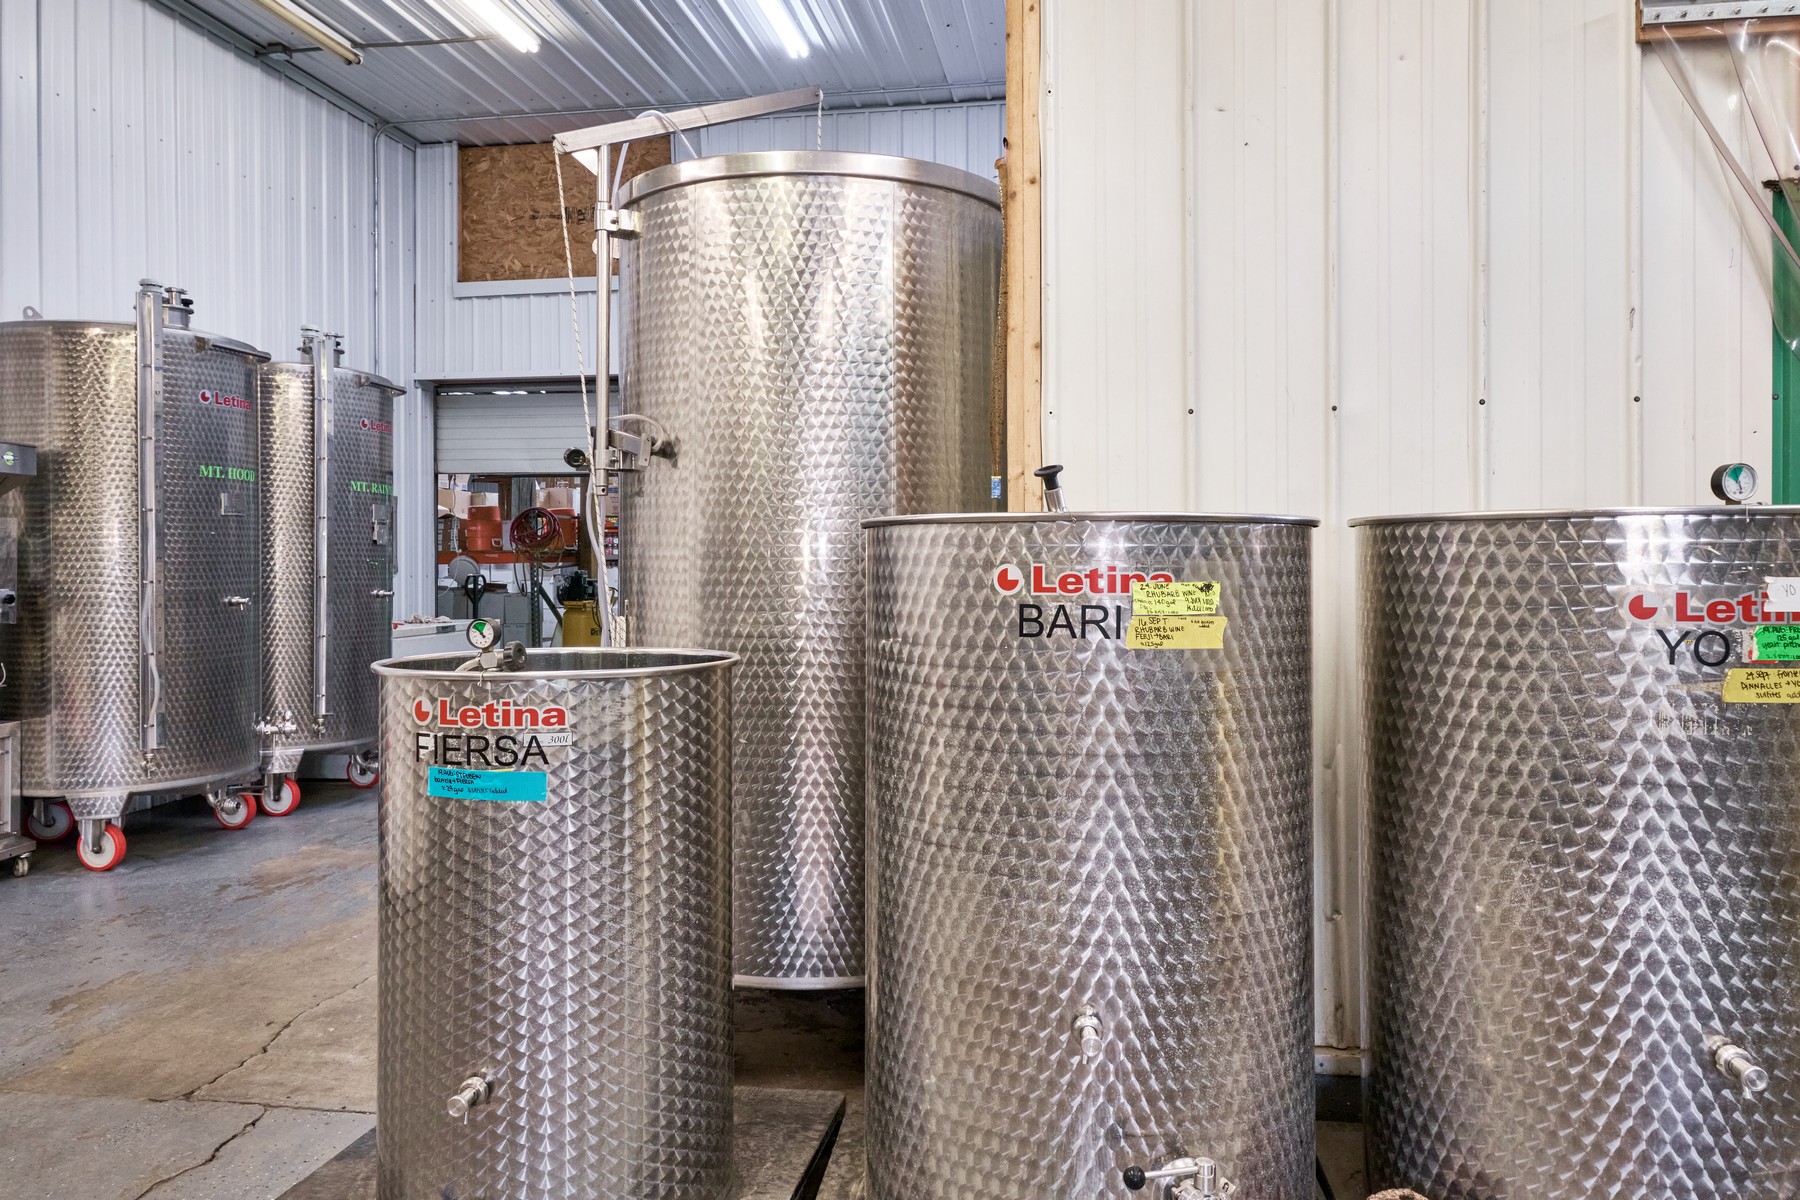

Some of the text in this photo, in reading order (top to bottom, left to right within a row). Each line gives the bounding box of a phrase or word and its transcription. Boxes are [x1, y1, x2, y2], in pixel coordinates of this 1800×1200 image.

[214, 391, 251, 411] Letina
[199, 465, 255, 481] MT. HOOD
[350, 481, 370, 493] MT.
[1146, 590, 1180, 598] RHUBARB
[1018, 604, 1121, 640] BARI
[1135, 626, 1168, 634] RHUBARB
[1656, 629, 1731, 667] YO
[439, 699, 567, 728] Letina
[416, 732, 549, 766] FIERSA
